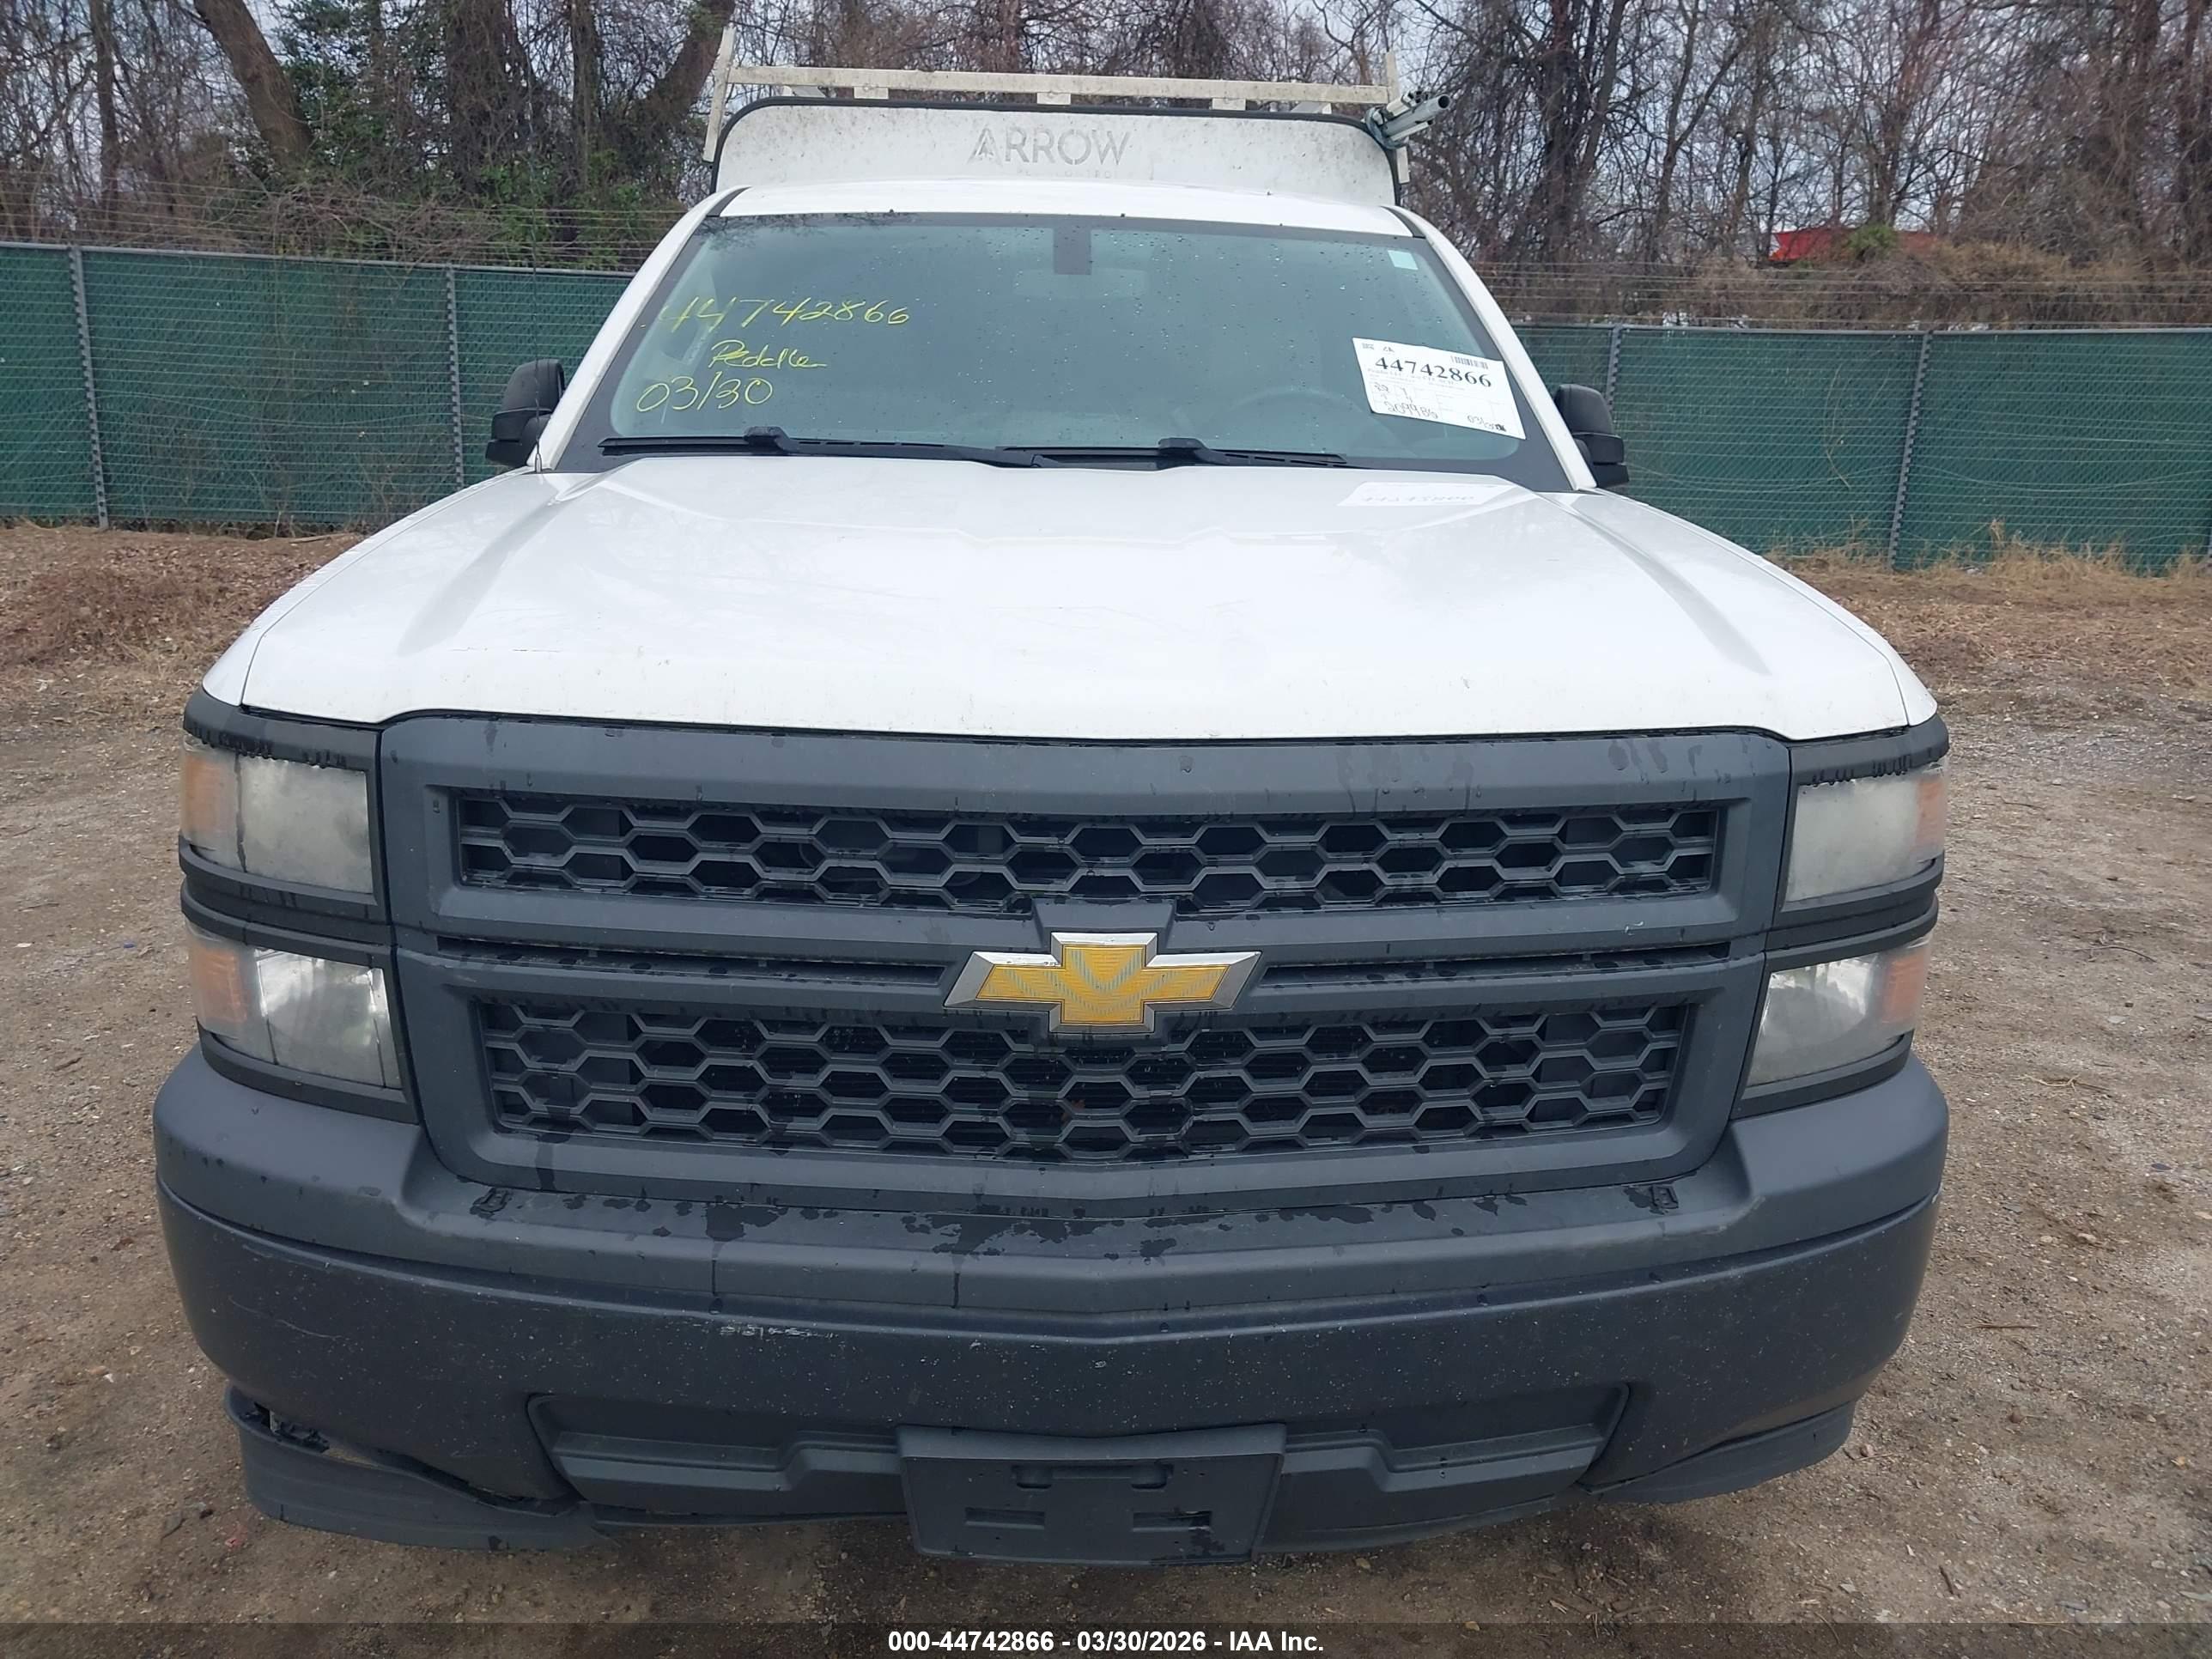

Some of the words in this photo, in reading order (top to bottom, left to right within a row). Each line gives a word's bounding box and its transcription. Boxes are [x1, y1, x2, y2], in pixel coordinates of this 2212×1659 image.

[967, 127, 1131, 167] ARROW
[659, 296, 910, 332] 44742866
[636, 371, 774, 412] 03/30
[1376, 357, 1492, 388] 44742866
